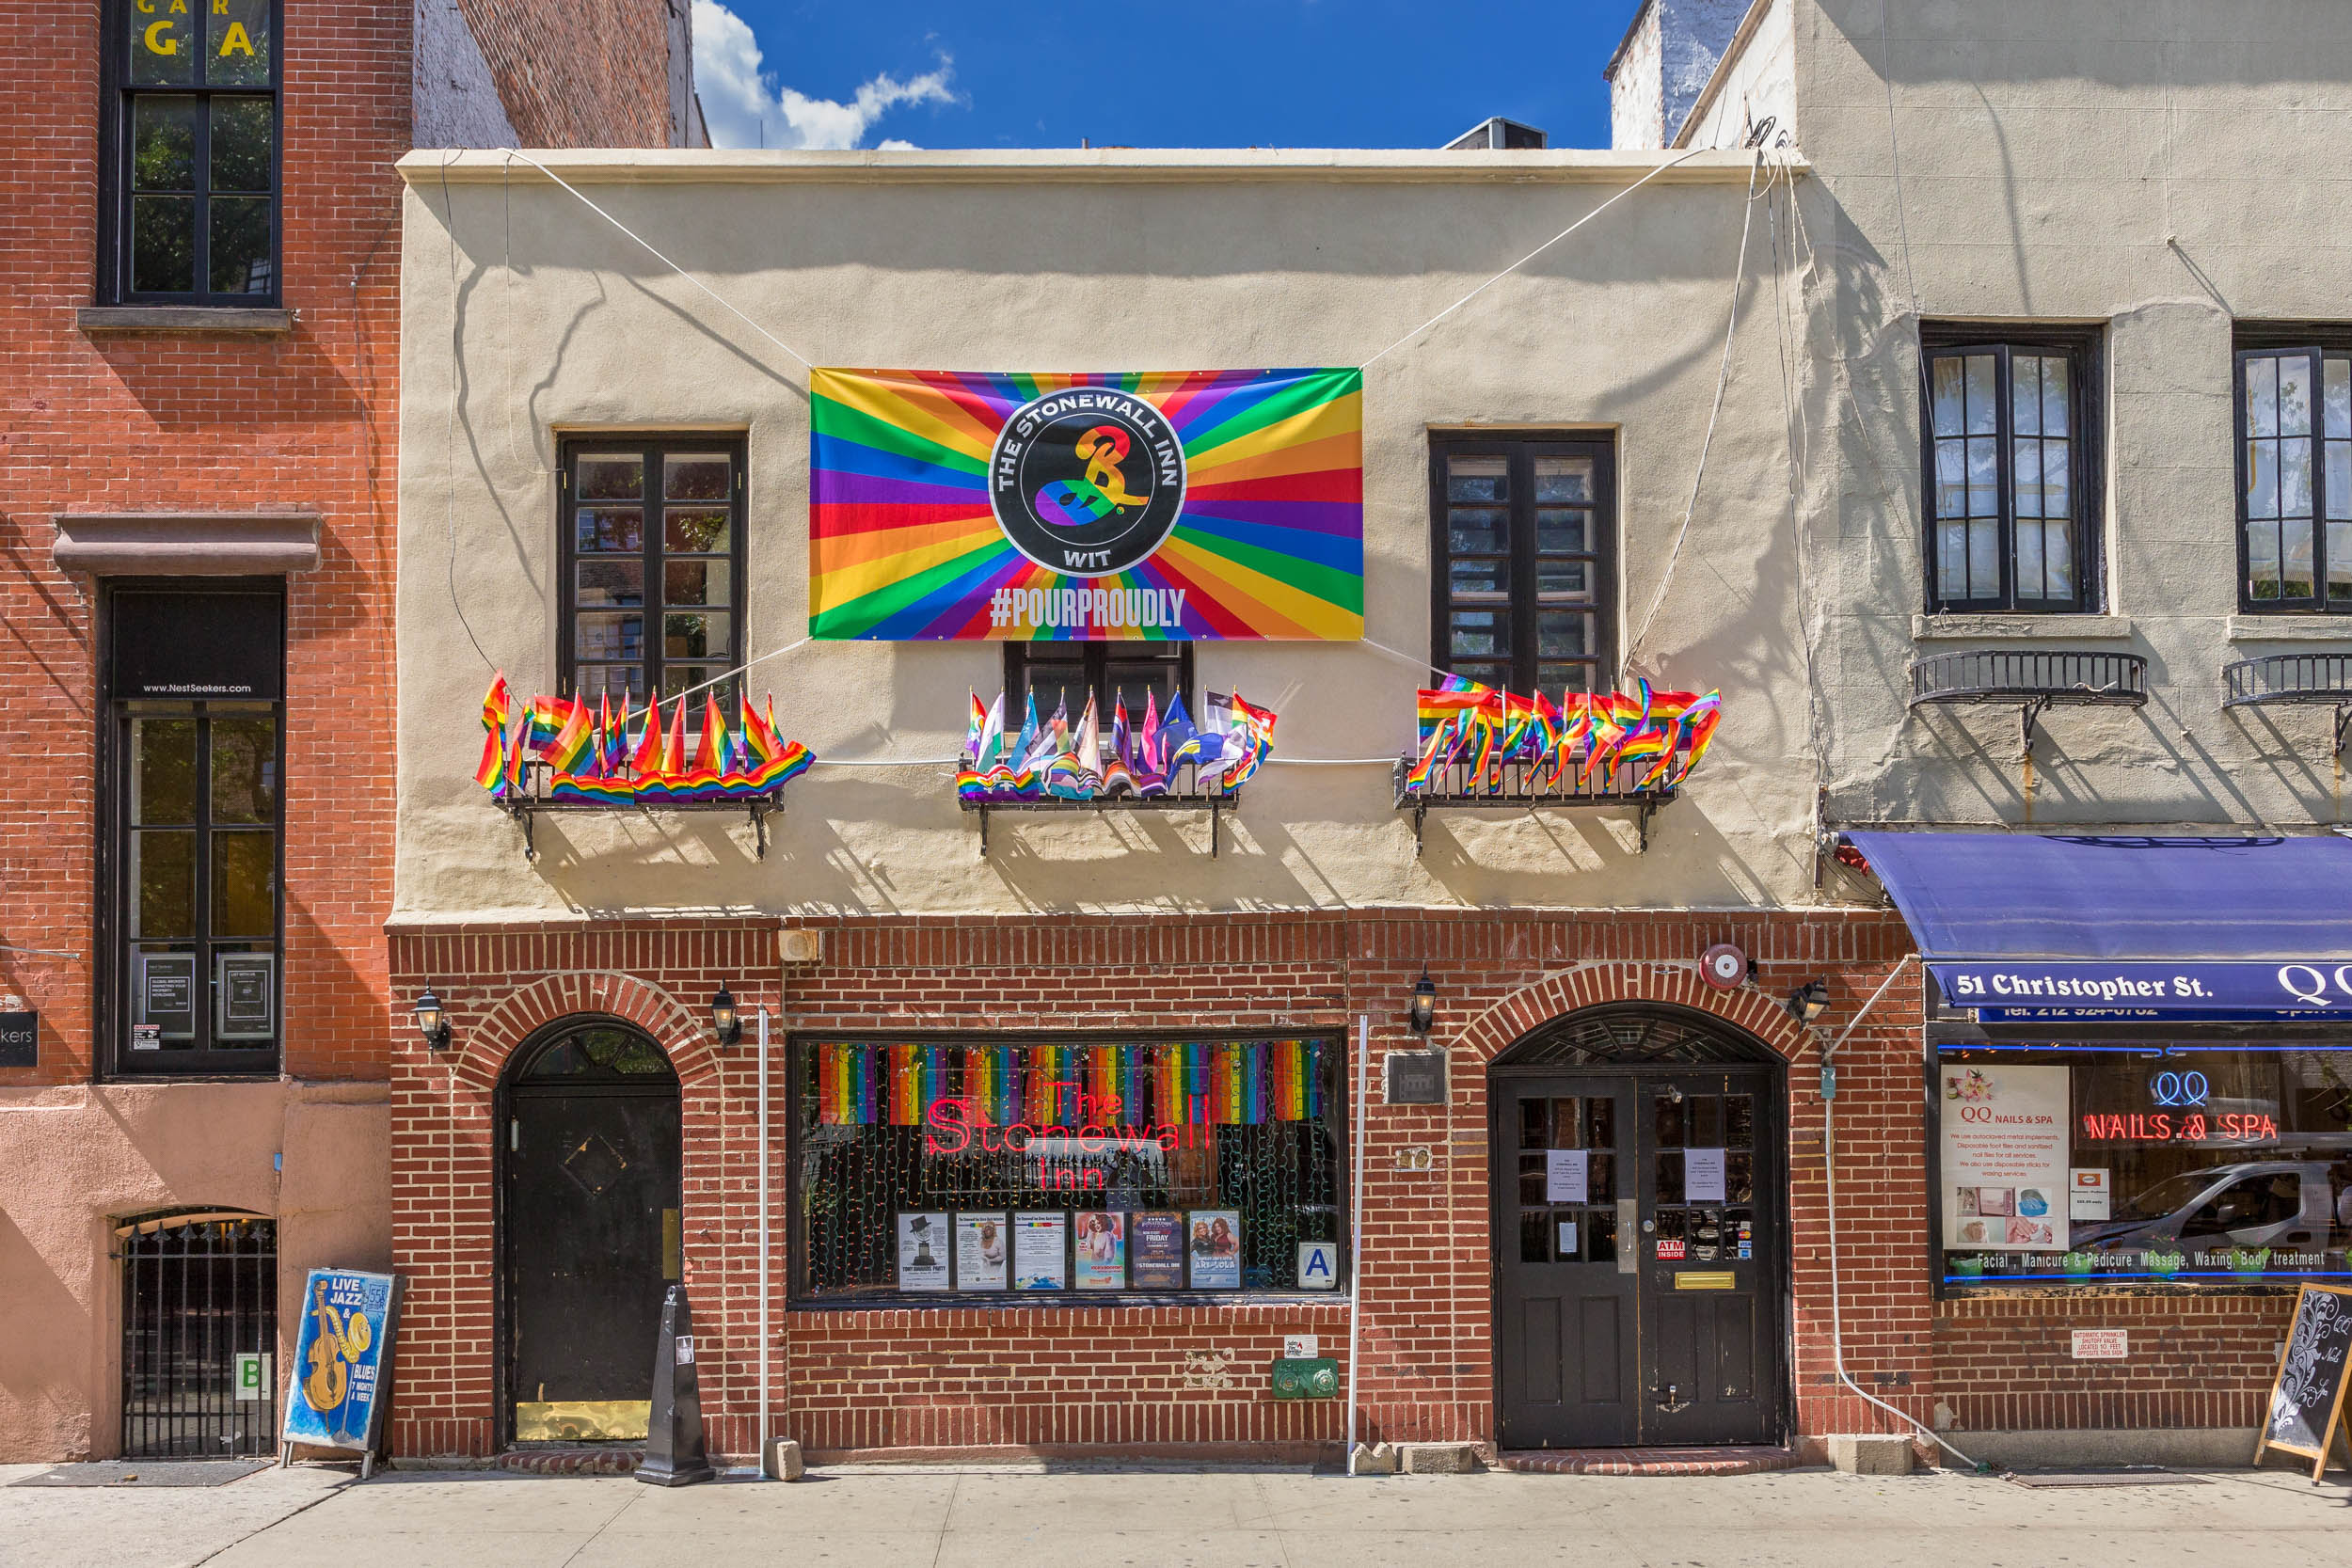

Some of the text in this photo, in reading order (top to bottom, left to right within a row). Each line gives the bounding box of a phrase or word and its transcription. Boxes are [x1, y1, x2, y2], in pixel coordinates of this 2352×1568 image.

[998, 393, 1177, 492] THE STONEWALL INN
[1063, 549, 1112, 568] WIT
[990, 587, 1186, 627] #POURPROUDLY
[143, 684, 251, 693] www.NestSeekers.com
[1957, 974, 2213, 1000] 51 Christopher St.
[1042, 1082, 1122, 1116] The
[2154, 1070, 2208, 1107] QQ
[927, 1093, 1210, 1156] Stonewall
[1961, 1106, 2053, 1124] QQ NAILS & SPA
[2089, 1114, 2170, 1140] NAILS
[2225, 1114, 2277, 1140] SPA
[1040, 1156, 1103, 1191] Inn
[1659, 1241, 1683, 1250] ATM
[1305, 1248, 1330, 1276] A
[2022, 1252, 2068, 1268] Manicure
[2074, 1253, 2081, 1267] &
[2087, 1252, 2132, 1267] Pedicure
[2140, 1251, 2189, 1269] Massage,
[2194, 1251, 2235, 1269] Waxing,
[2241, 1251, 2268, 1269] Body
[2273, 1251, 2325, 1266] treatment
[332, 1278, 360, 1291] LIVE
[330, 1292, 362, 1306] JAZZ
[343, 1308, 350, 1318] &
[243, 1360, 260, 1387] B
[353, 1364, 376, 1380] BLUES
